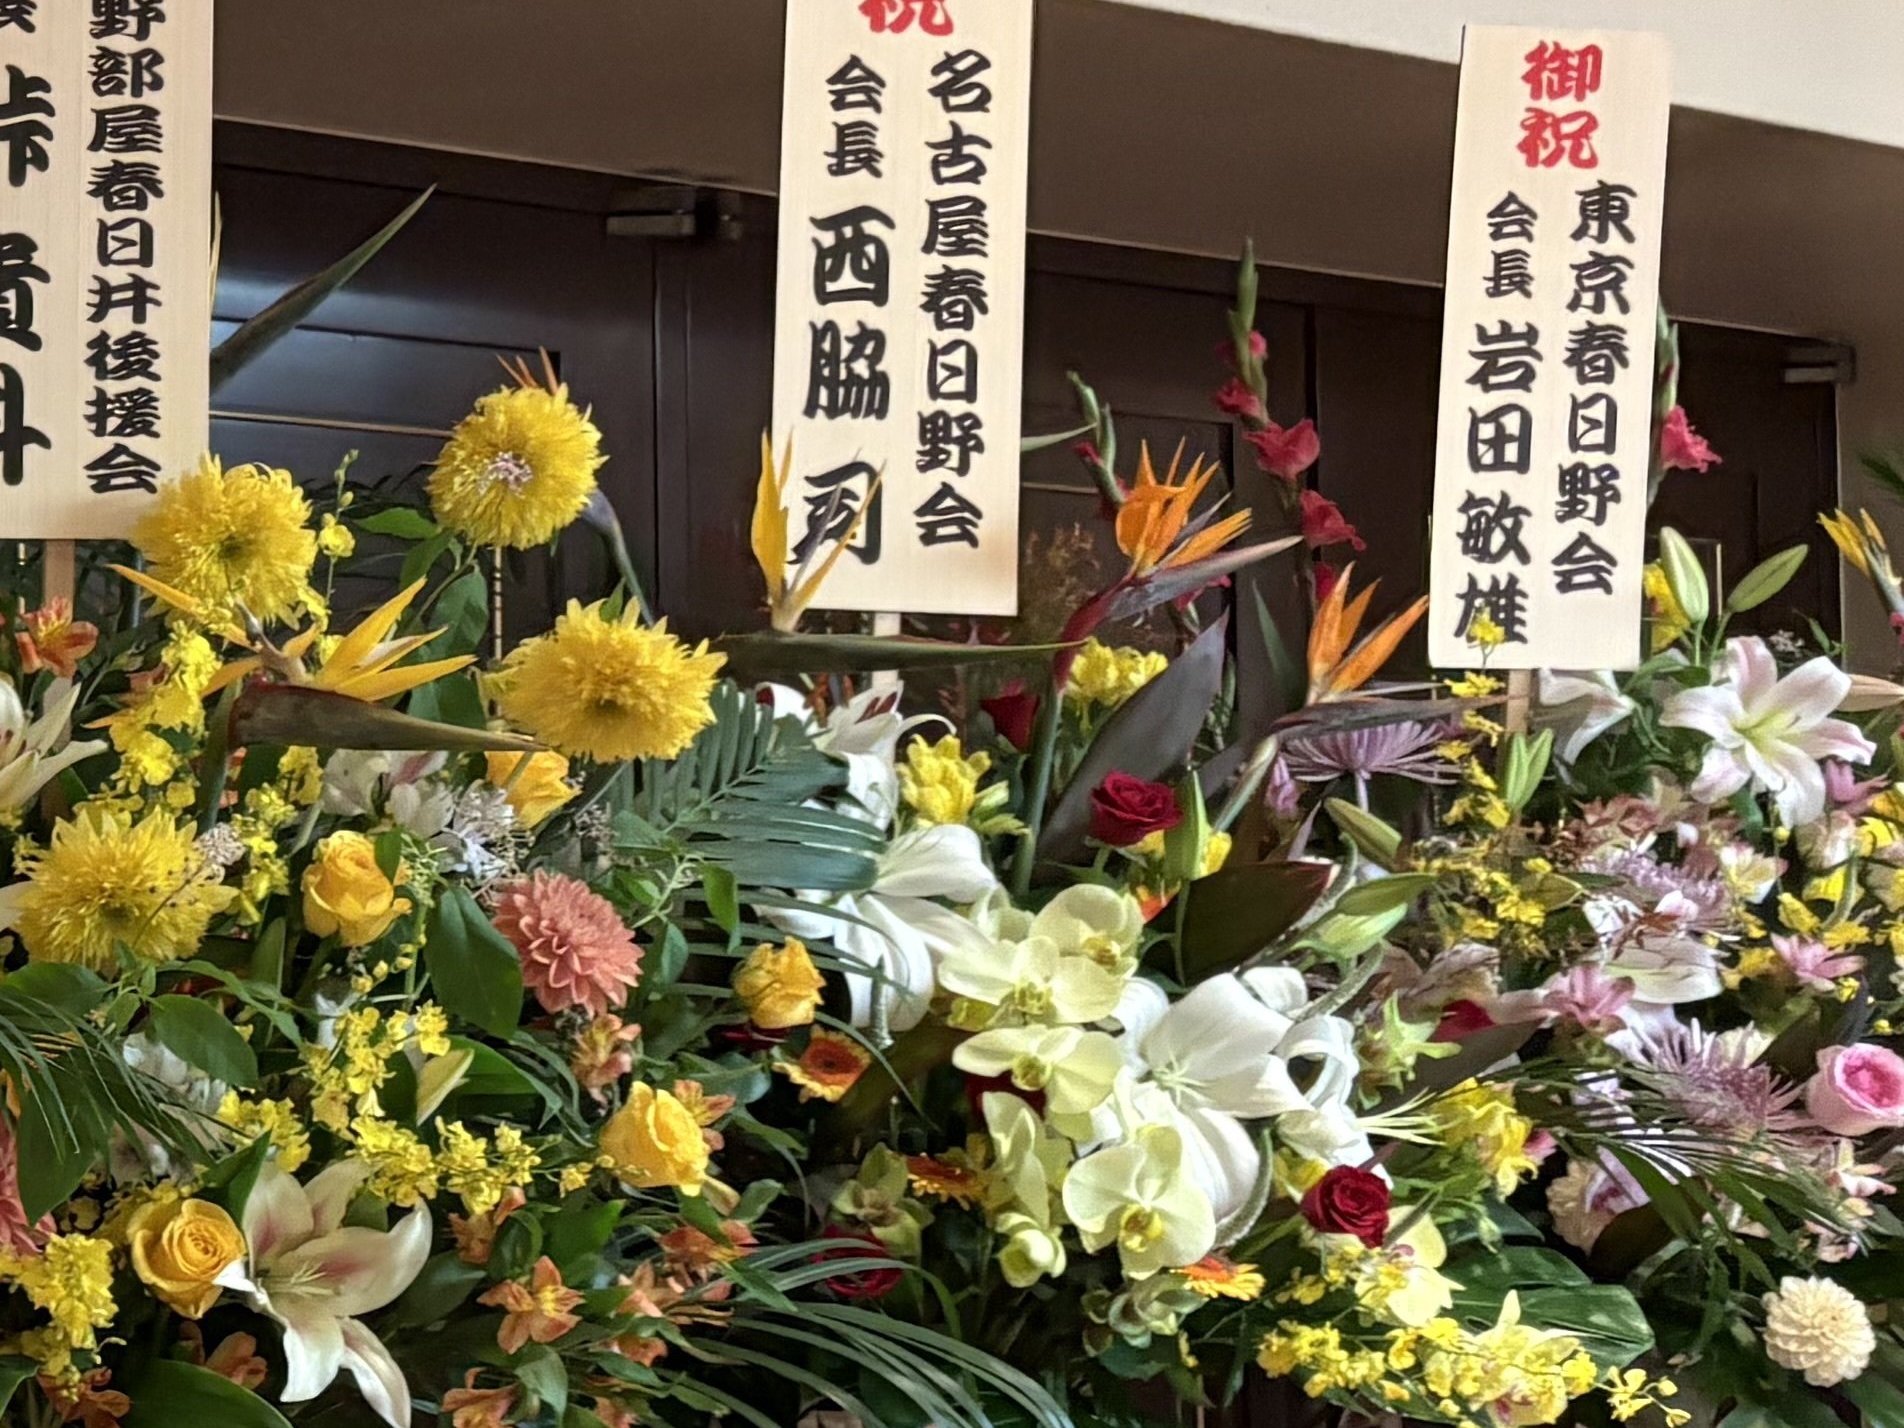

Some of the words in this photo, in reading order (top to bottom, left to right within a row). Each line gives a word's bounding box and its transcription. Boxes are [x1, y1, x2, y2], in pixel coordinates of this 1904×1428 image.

[914, 49, 992, 548] 名古屋春日野会
[1518, 43, 1603, 169] 御祝
[1551, 180, 1636, 595] 東京春日野会
